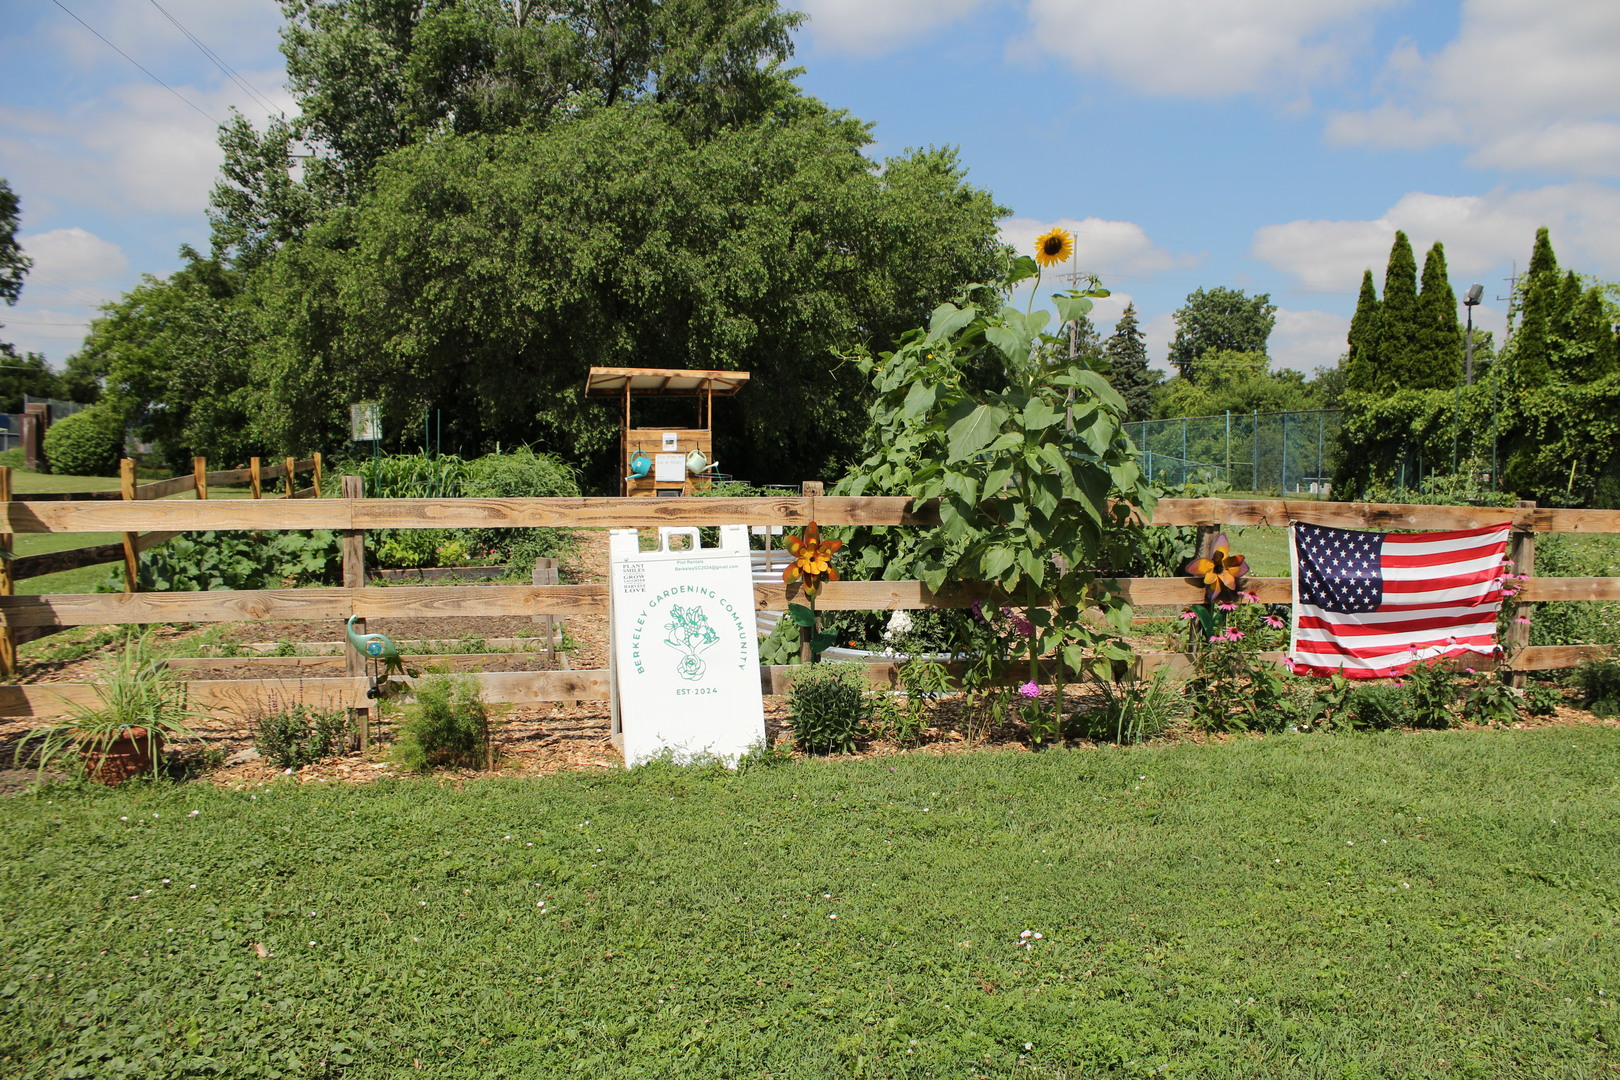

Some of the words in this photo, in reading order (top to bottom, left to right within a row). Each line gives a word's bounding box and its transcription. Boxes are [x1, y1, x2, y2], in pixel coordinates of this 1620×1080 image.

[632, 610, 648, 675] BERKELEY
[649, 585, 716, 608] GARDENING
[719, 598, 748, 671] COMMUNITY
